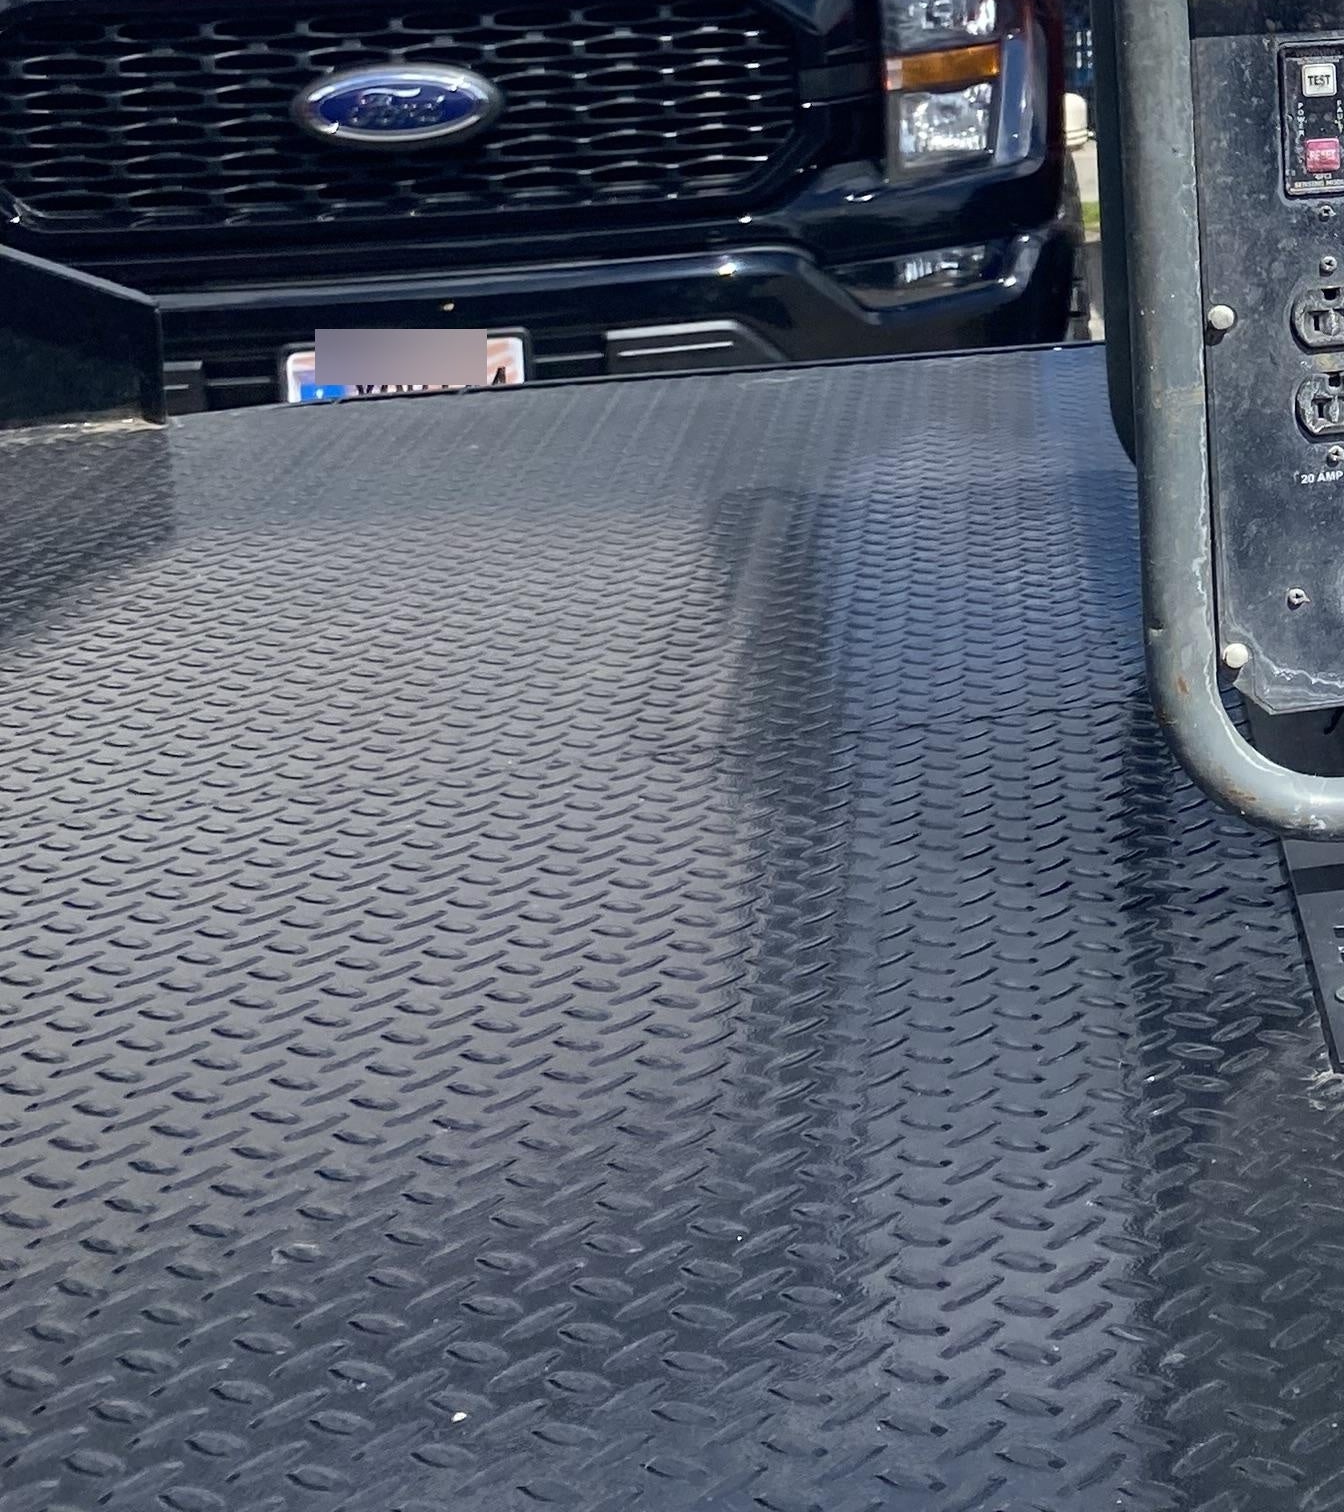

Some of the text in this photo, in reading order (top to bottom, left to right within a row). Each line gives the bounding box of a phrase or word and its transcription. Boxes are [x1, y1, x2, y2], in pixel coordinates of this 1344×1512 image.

[1307, 75, 1331, 86] TEST
[1310, 149, 1336, 159] RESET
[1301, 473, 1315, 484] 20
[1317, 470, 1344, 482] AMP
